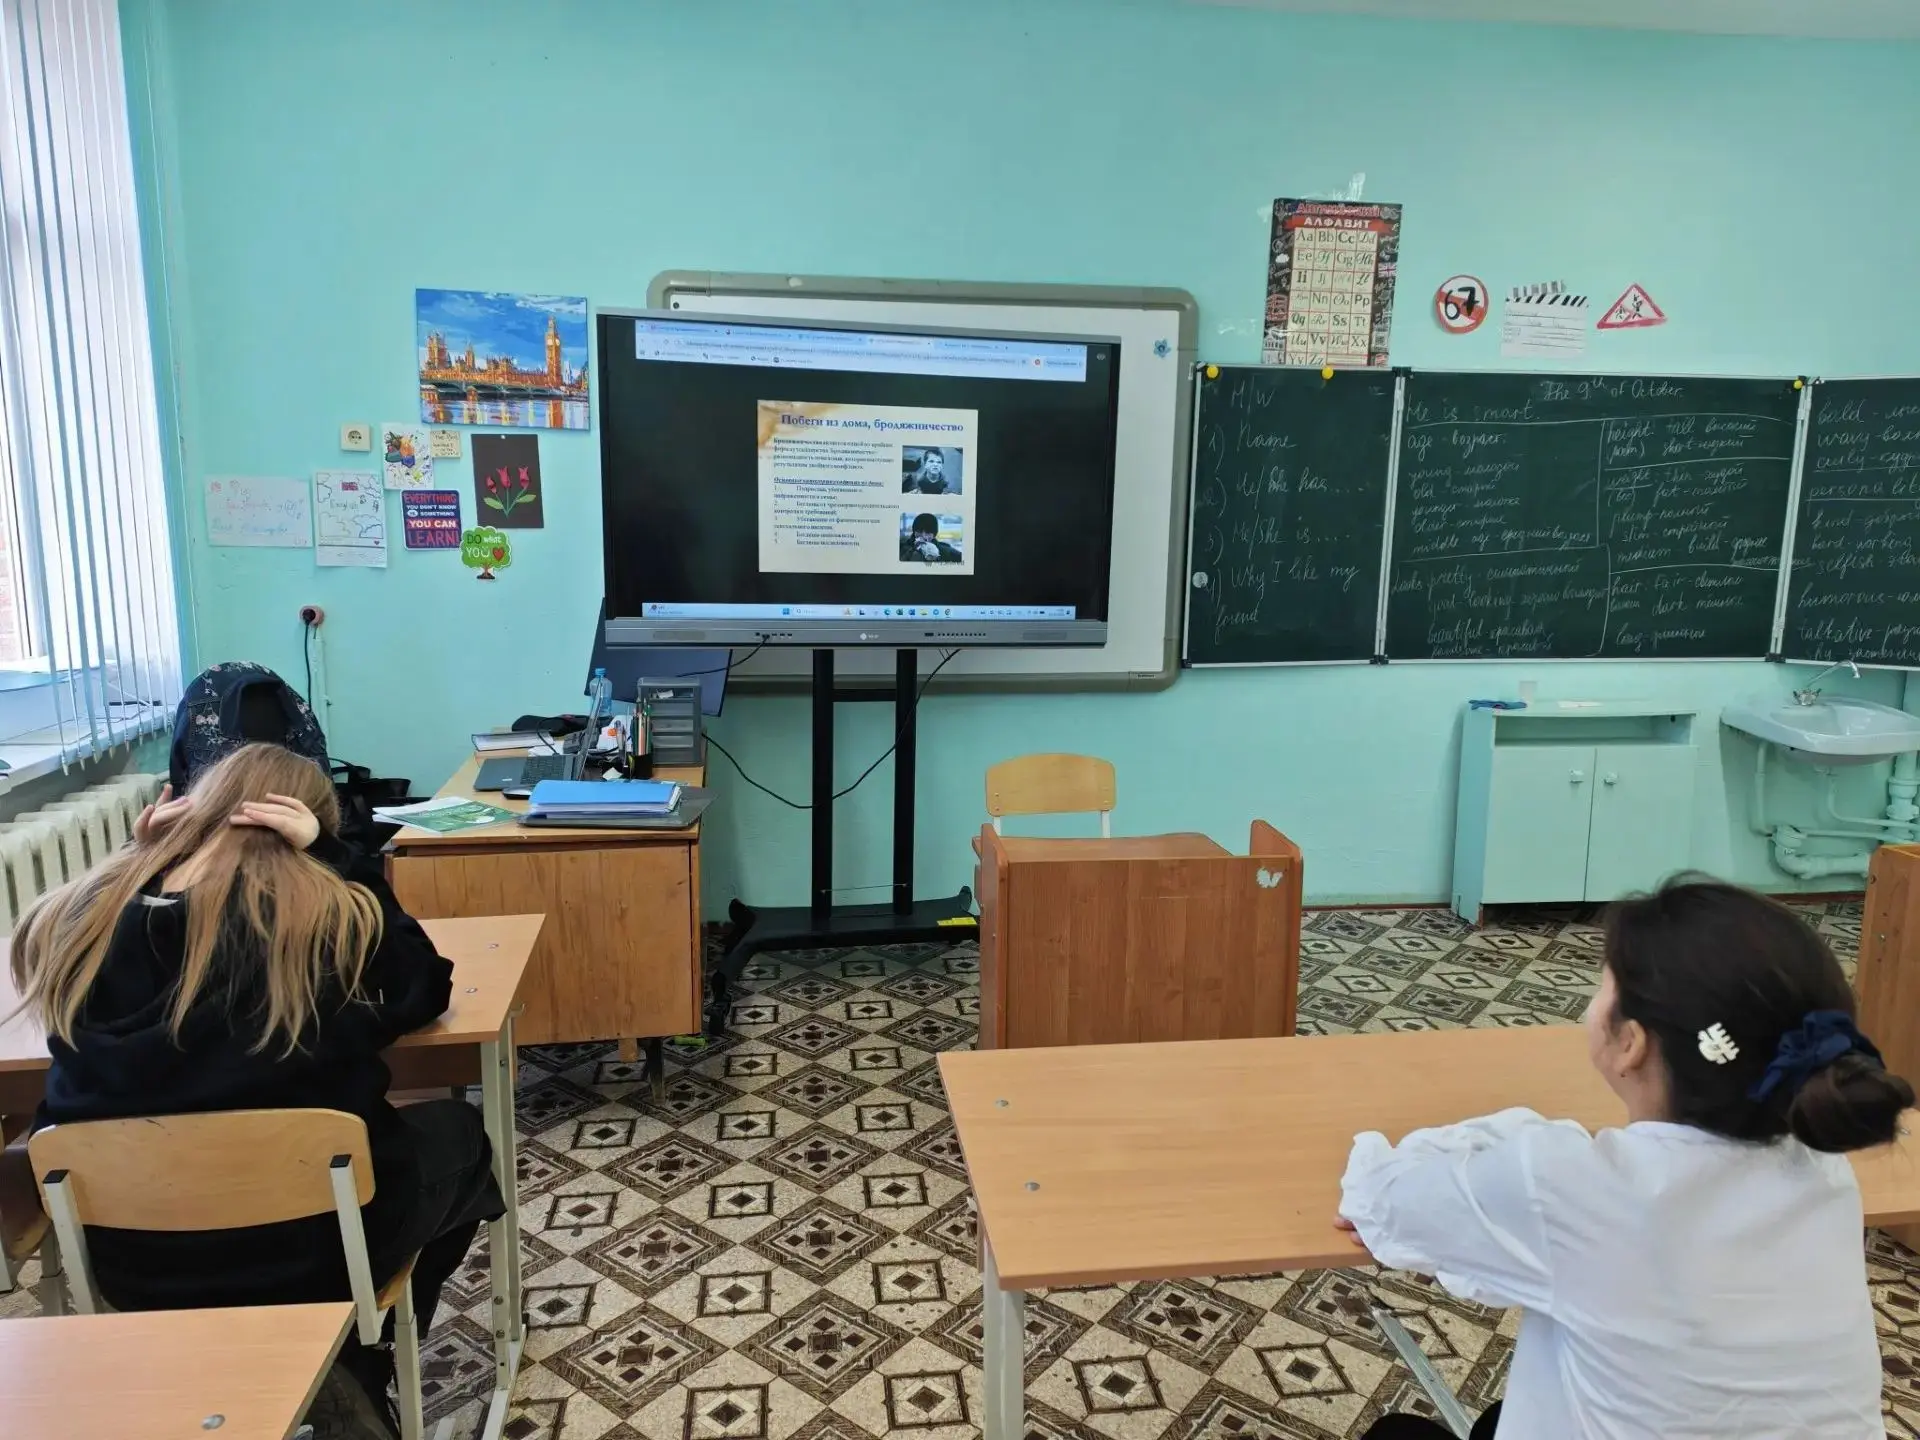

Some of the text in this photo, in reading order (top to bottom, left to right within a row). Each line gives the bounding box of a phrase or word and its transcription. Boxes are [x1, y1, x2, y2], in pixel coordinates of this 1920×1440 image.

[1304, 217, 1370, 228] АЛФАВИТ
[1296, 229, 1313, 241] Aa
[1318, 231, 1334, 243] Bb
[1338, 231, 1355, 244] Cc
[1297, 249, 1312, 260] Ee
[1336, 252, 1353, 267] Gg
[1296, 271, 1307, 283] Ii
[1313, 292, 1328, 305] Nn
[1334, 294, 1349, 305] Oo
[1355, 294, 1370, 308] Pp
[1444, 286, 1479, 320] 67
[1292, 313, 1306, 326] Qq
[1332, 314, 1347, 326] Ss
[1354, 316, 1366, 327] Tt
[1310, 333, 1326, 345] Vv
[1351, 335, 1367, 347] Xx
[781, 414, 823, 427] Побеги
[842, 421, 871, 430] дома,
[874, 418, 964, 432] бродяжничество
[1408, 433, 1432, 462] age
[404, 493, 457, 504] EVERYTHING
[410, 520, 457, 528] YOU CAN
[408, 530, 459, 547] LEARN!
[467, 534, 482, 545] DO
[466, 546, 490, 558] YOU
[1289, 559, 1319, 581] like
